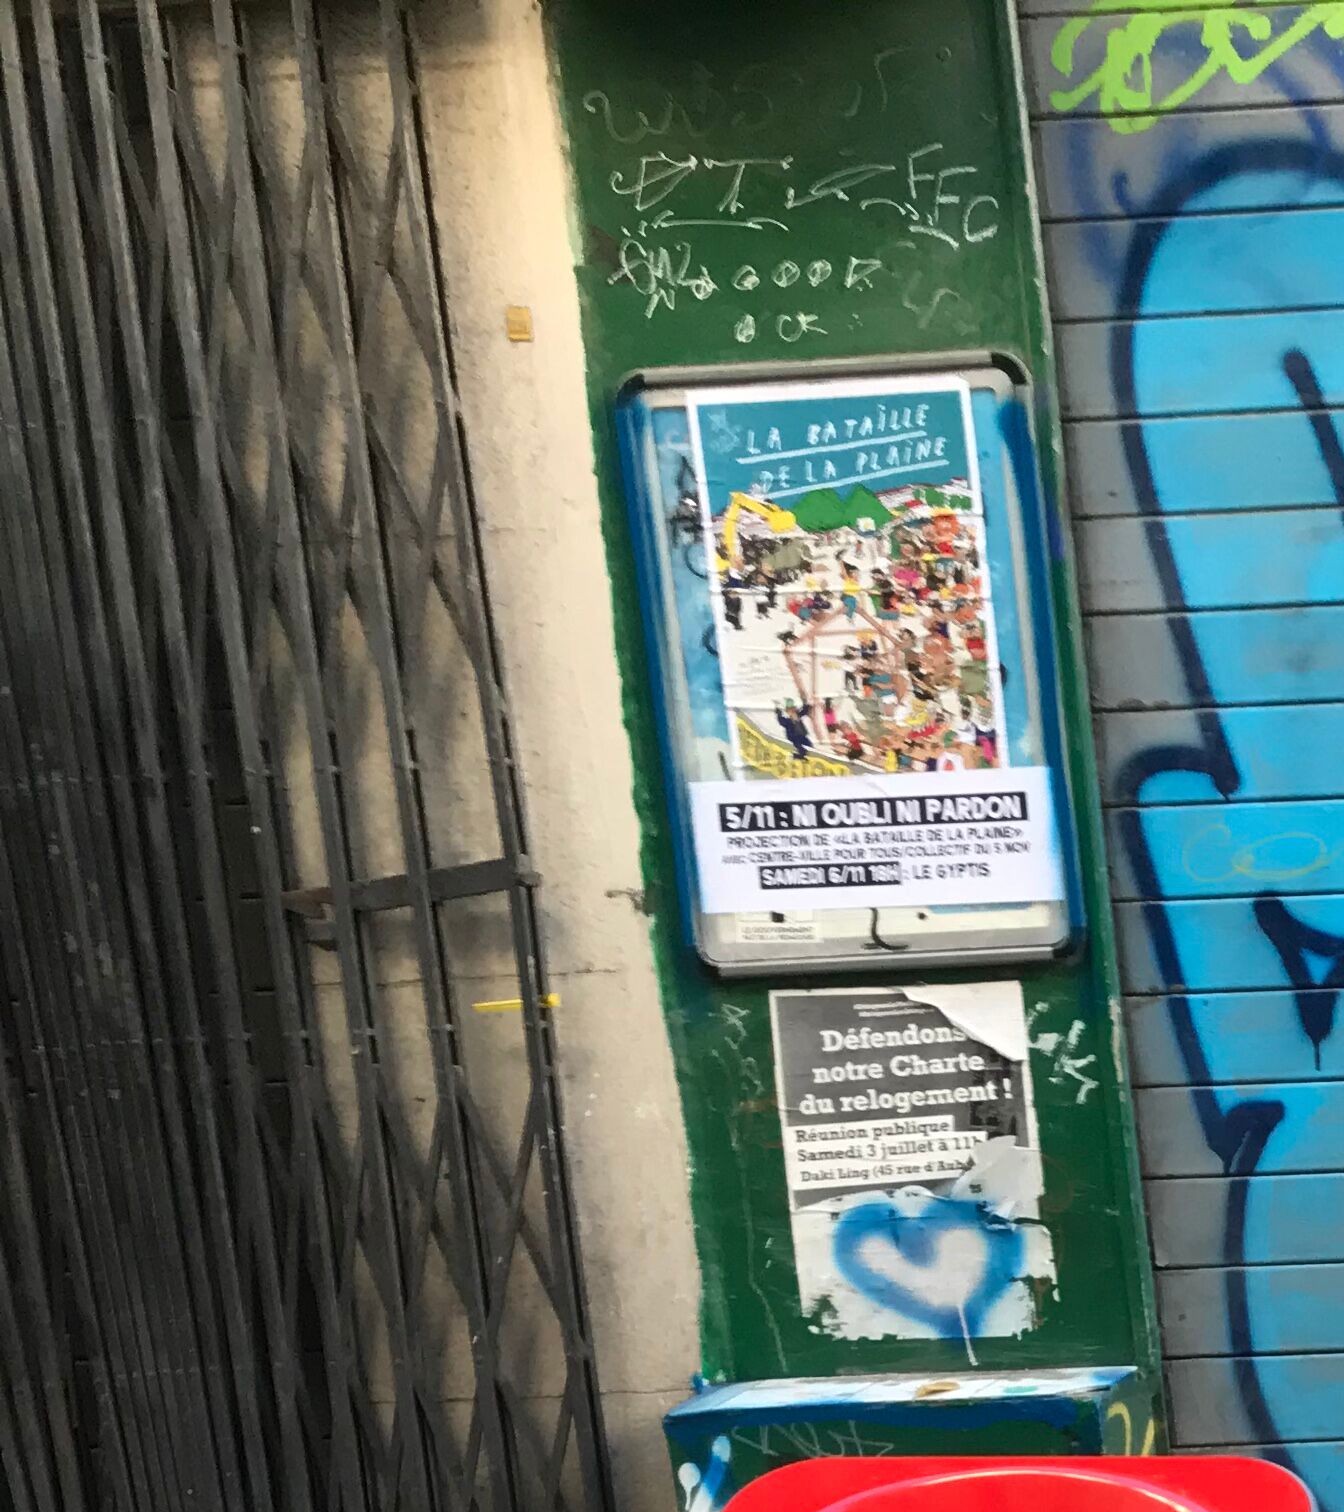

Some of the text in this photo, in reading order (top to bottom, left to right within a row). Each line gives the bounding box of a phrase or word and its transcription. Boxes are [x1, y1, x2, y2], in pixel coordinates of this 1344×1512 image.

[748, 426, 783, 455] LA
[805, 458, 838, 483] LA
[725, 805, 776, 829] 5/11
[792, 802, 818, 828] NI
[822, 799, 893, 826] OUBLI
[896, 799, 922, 823] NI
[925, 794, 1023, 822] PARDON
[727, 833, 811, 850] PROJECTION
[813, 833, 832, 847] DE
[863, 828, 924, 846] BATAILLE
[926, 827, 943, 842] DE
[946, 827, 965, 841] LA
[833, 847, 865, 861] POUR
[762, 866, 826, 886] SAMEDI
[828, 864, 866, 884] 6/11
[912, 865, 932, 880] LE
[935, 863, 992, 881] GYPTIS
[820, 1024, 967, 1051] Défendons
[812, 1053, 986, 1084] notre Charte
[799, 1094, 835, 1115] du
[839, 1080, 998, 1113] relogement
[795, 1120, 948, 1143] Réunion publique
[797, 1146, 863, 1163] Samedi
[867, 1143, 876, 1157] 3
[881, 1140, 934, 1160] juillet
[838, 1167, 869, 1182] Ling
[896, 1164, 921, 1175] rue
